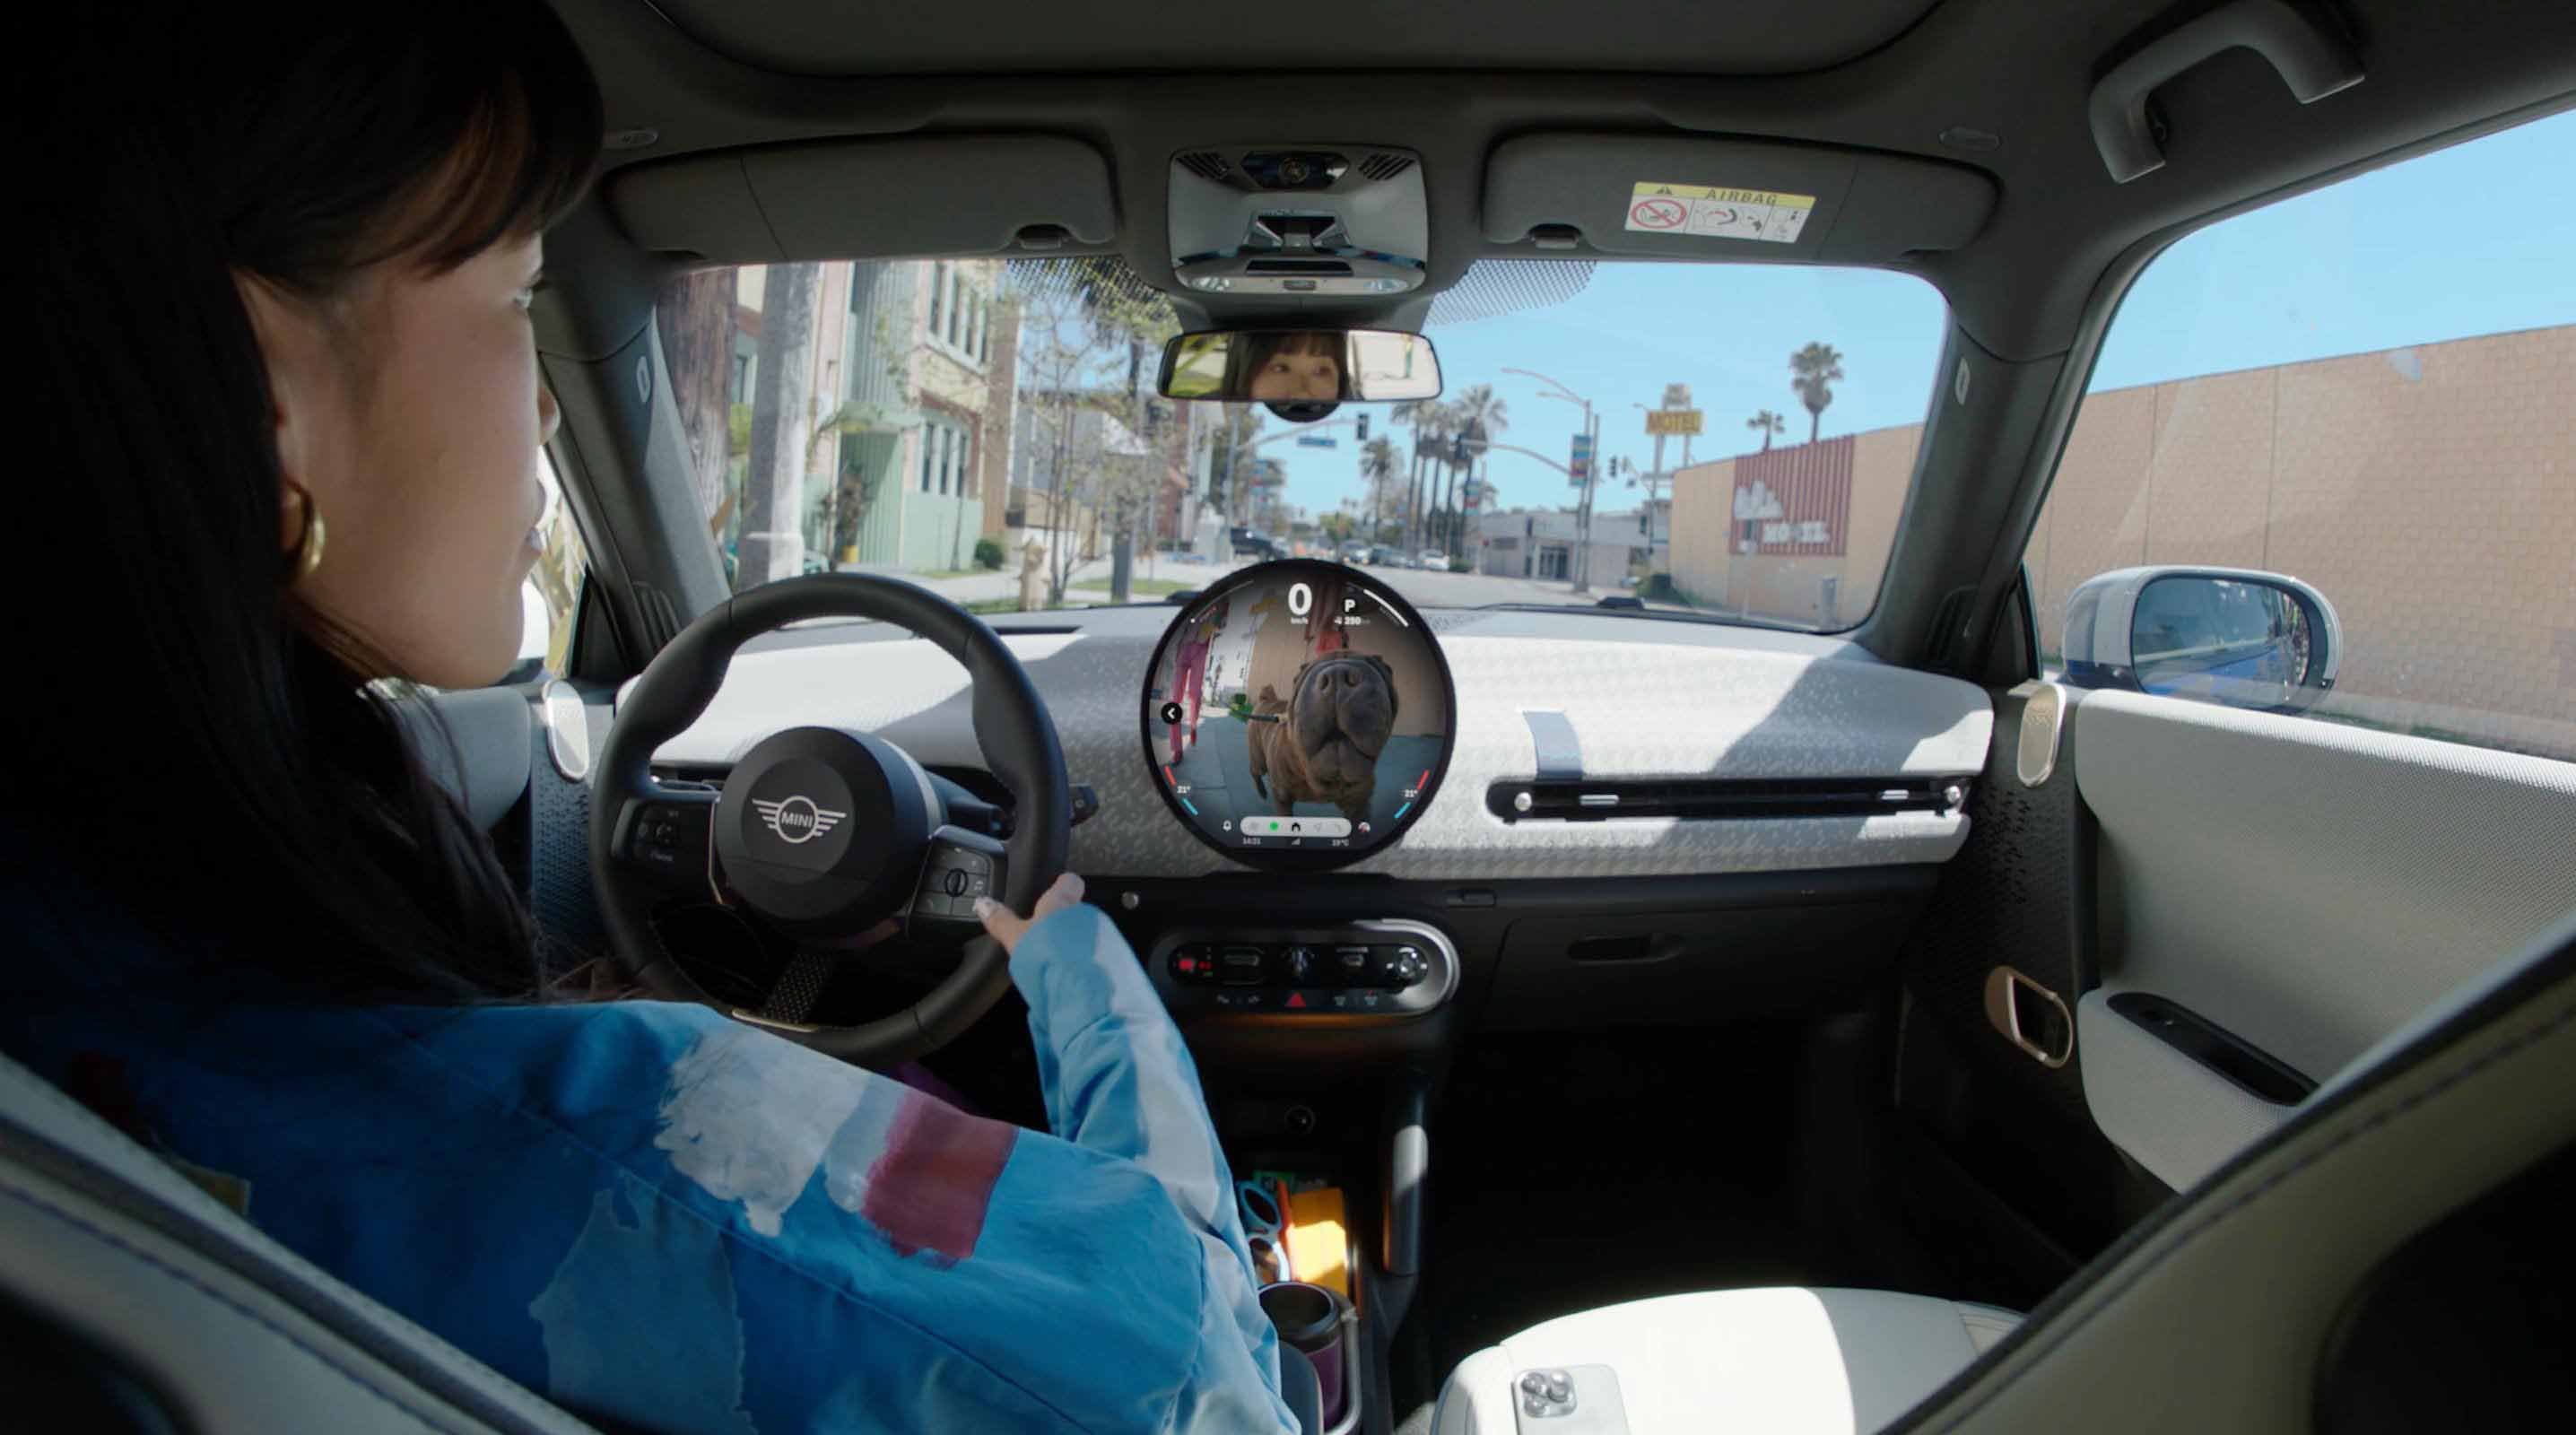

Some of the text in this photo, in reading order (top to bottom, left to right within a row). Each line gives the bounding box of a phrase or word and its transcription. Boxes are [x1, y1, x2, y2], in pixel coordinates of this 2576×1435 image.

[1705, 188, 1778, 206] AIRBAG
[1648, 412, 1701, 432] MOTEL
[1288, 582, 1312, 615] 0
[1345, 599, 1355, 613] P
[781, 810, 814, 829] MINI
